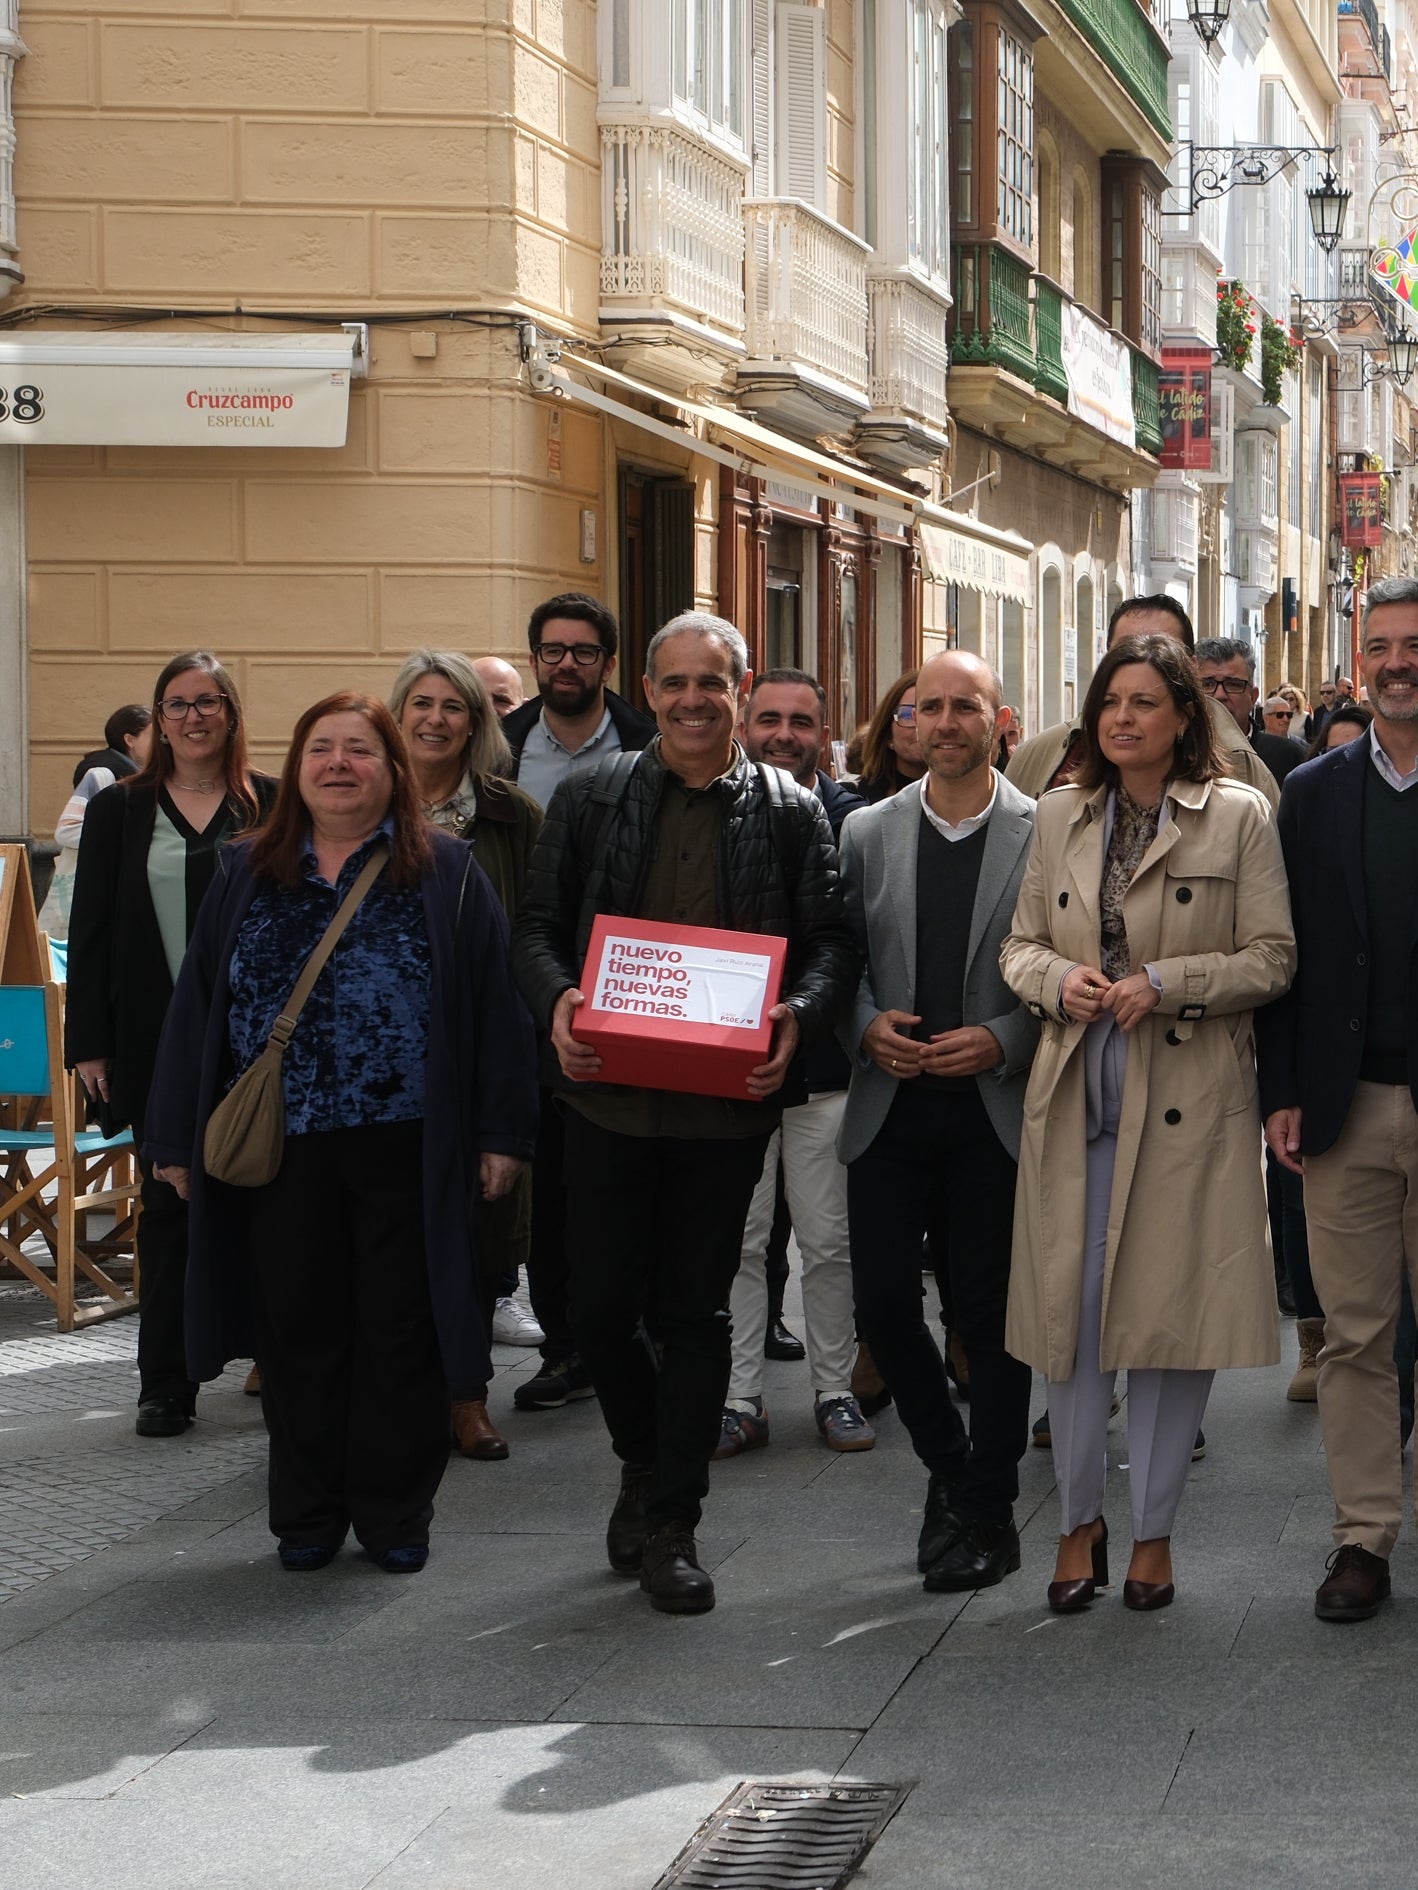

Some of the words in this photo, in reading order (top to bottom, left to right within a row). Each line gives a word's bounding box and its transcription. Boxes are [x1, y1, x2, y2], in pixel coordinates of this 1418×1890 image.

[0, 384, 46, 424] 8
[186, 389, 294, 413] Cruzcampo
[1169, 387, 1205, 405] latido
[207, 415, 275, 428] ESPECIAL
[1171, 406, 1205, 421] Cádiz
[610, 942, 683, 964] nuevo
[608, 957, 692, 986] tiempo,
[604, 977, 688, 1000] nuevas
[601, 991, 688, 1018] formas.
[720, 1016, 739, 1024] PSOE
